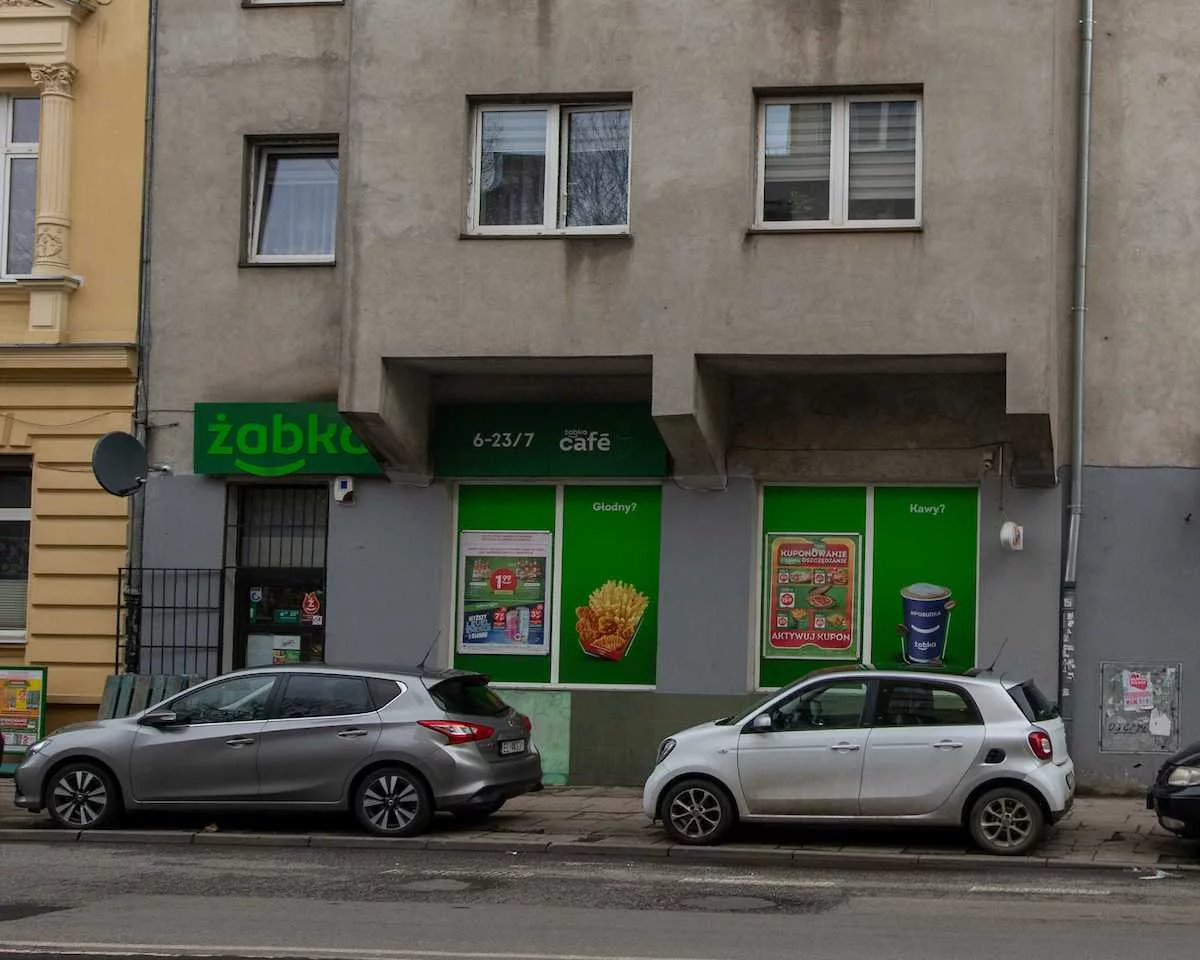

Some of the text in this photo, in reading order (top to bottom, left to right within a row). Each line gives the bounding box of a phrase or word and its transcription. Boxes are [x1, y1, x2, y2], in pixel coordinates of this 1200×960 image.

[472, 432, 535, 448] 6-23/7
[592, 502, 637, 514] Głodny?
[910, 503, 946, 515] Kawy?
[771, 632, 851, 641] AKTYWUJ KUPON
